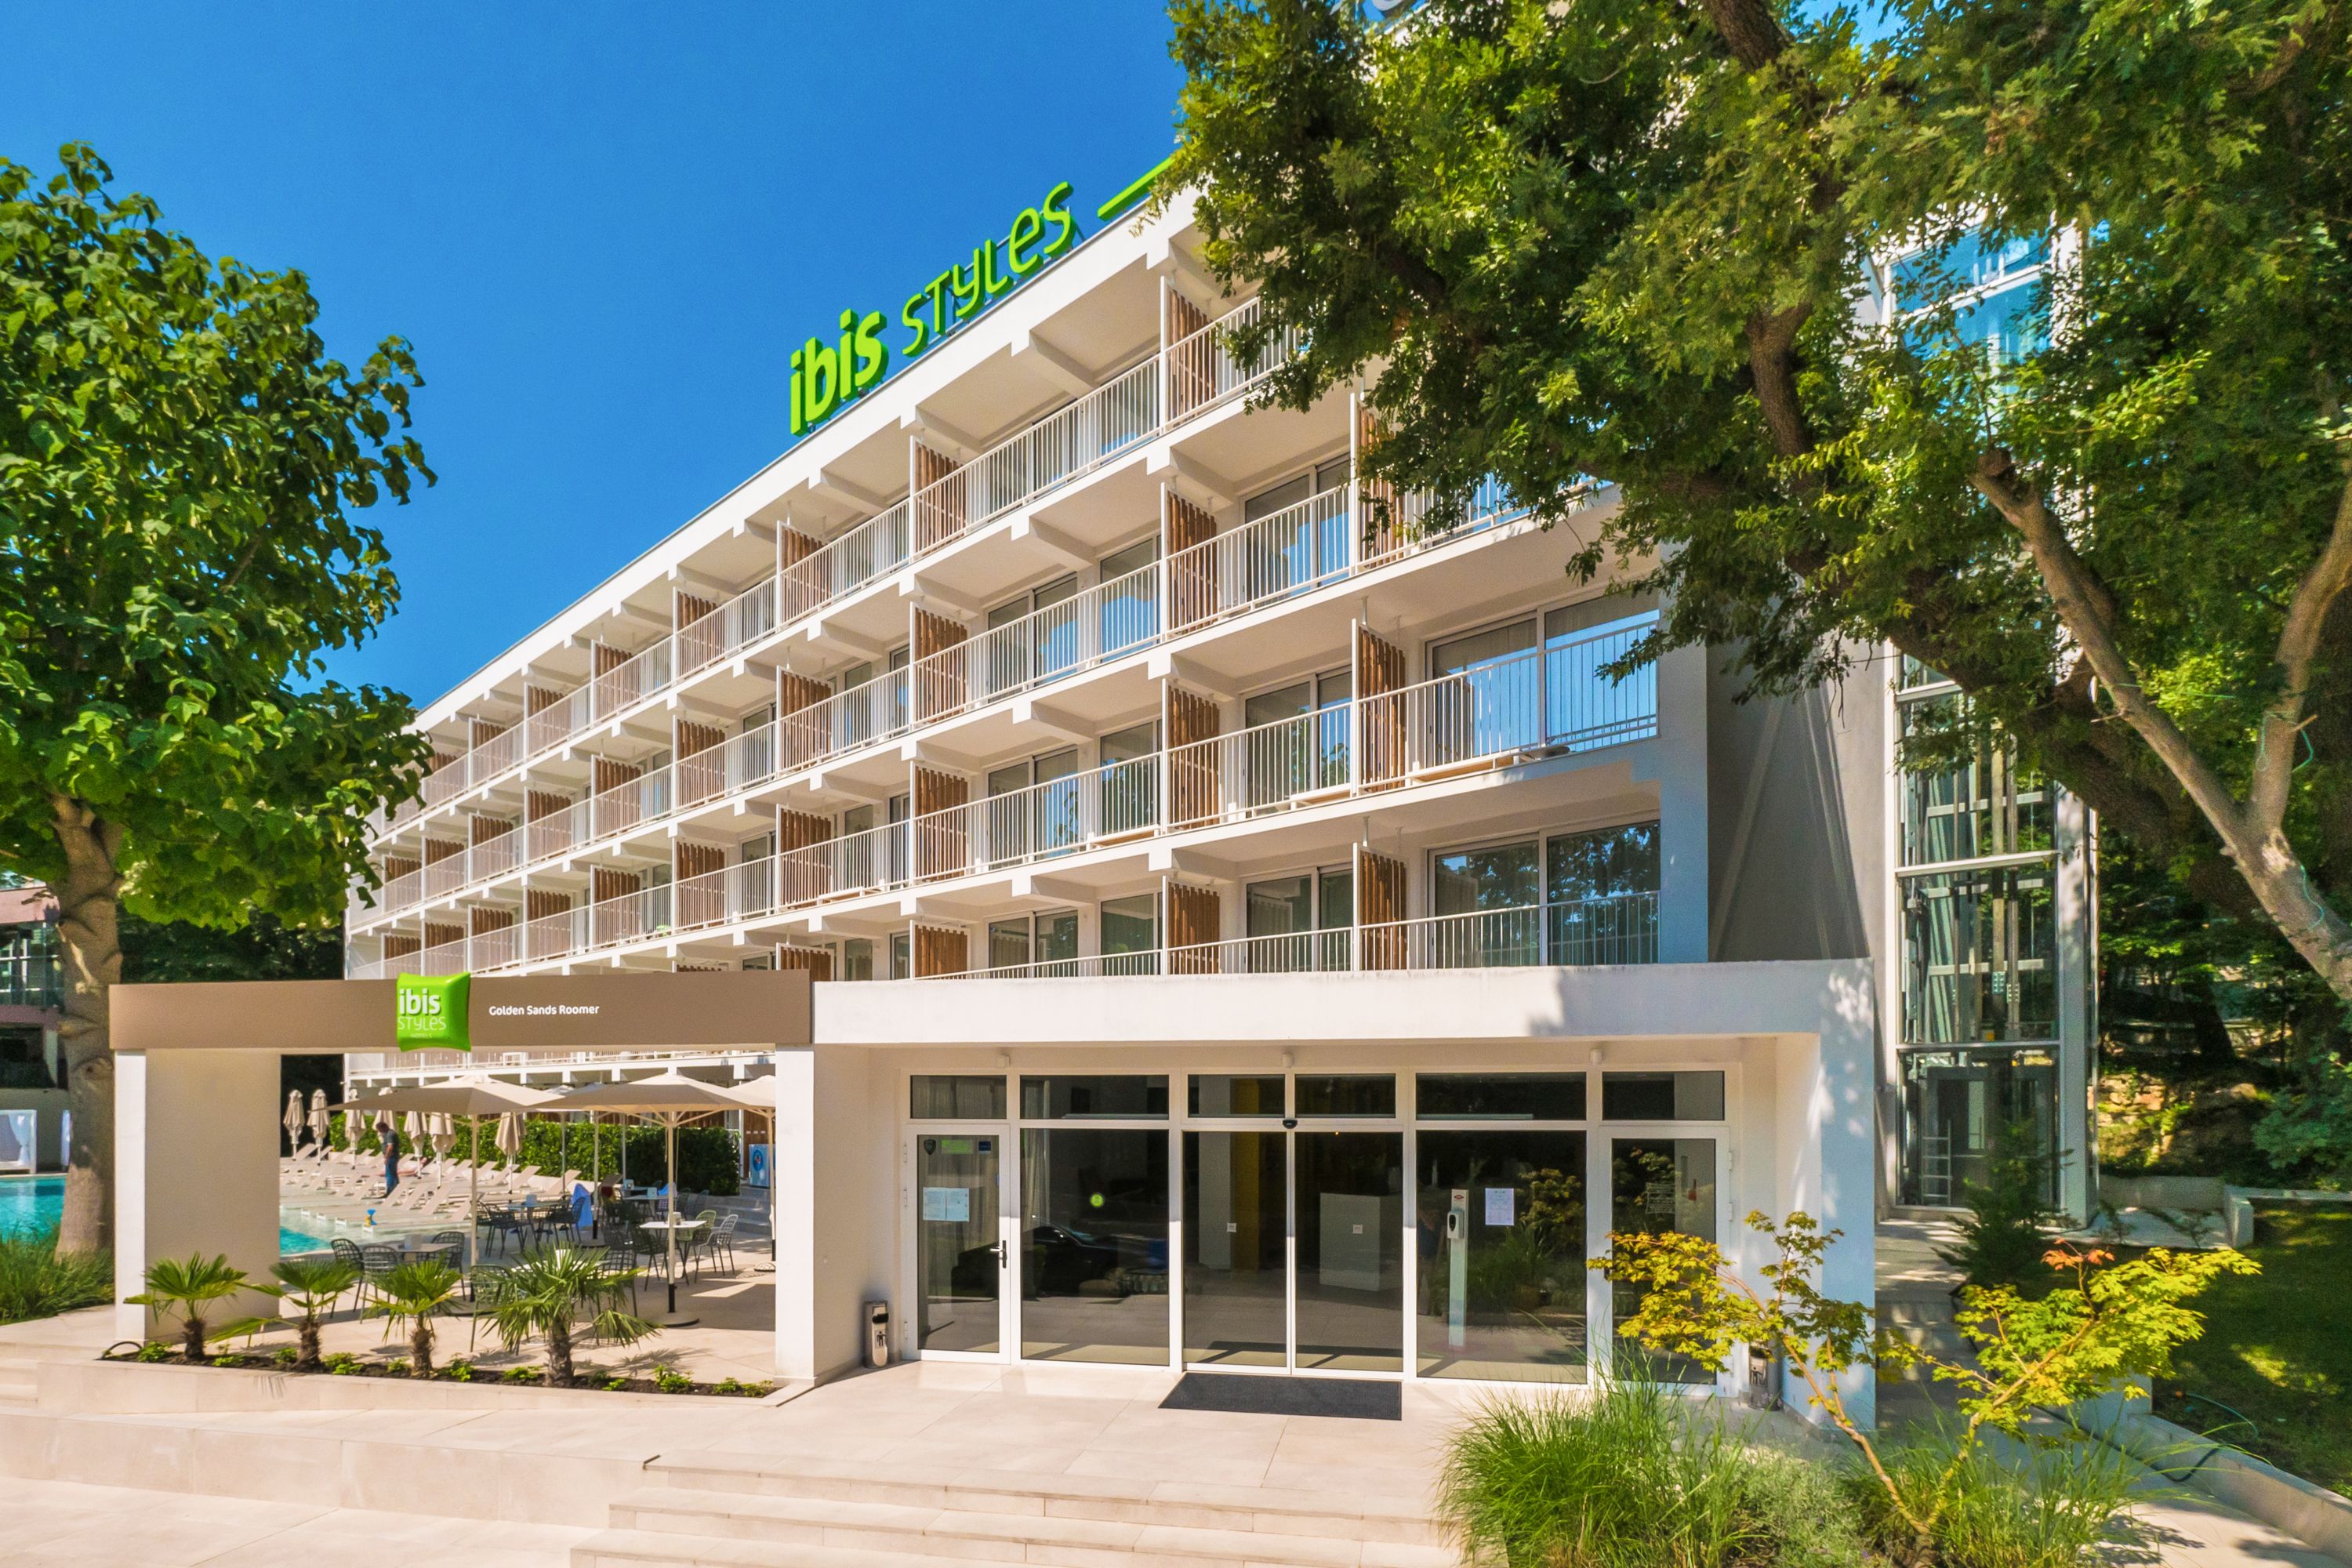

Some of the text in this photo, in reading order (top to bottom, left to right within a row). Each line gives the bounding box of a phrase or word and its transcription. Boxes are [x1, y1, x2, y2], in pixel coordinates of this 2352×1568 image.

[790, 309, 887, 437] ibis
[399, 989, 441, 1015] ibis
[489, 1004, 600, 1016] Golden Sands Roomer
